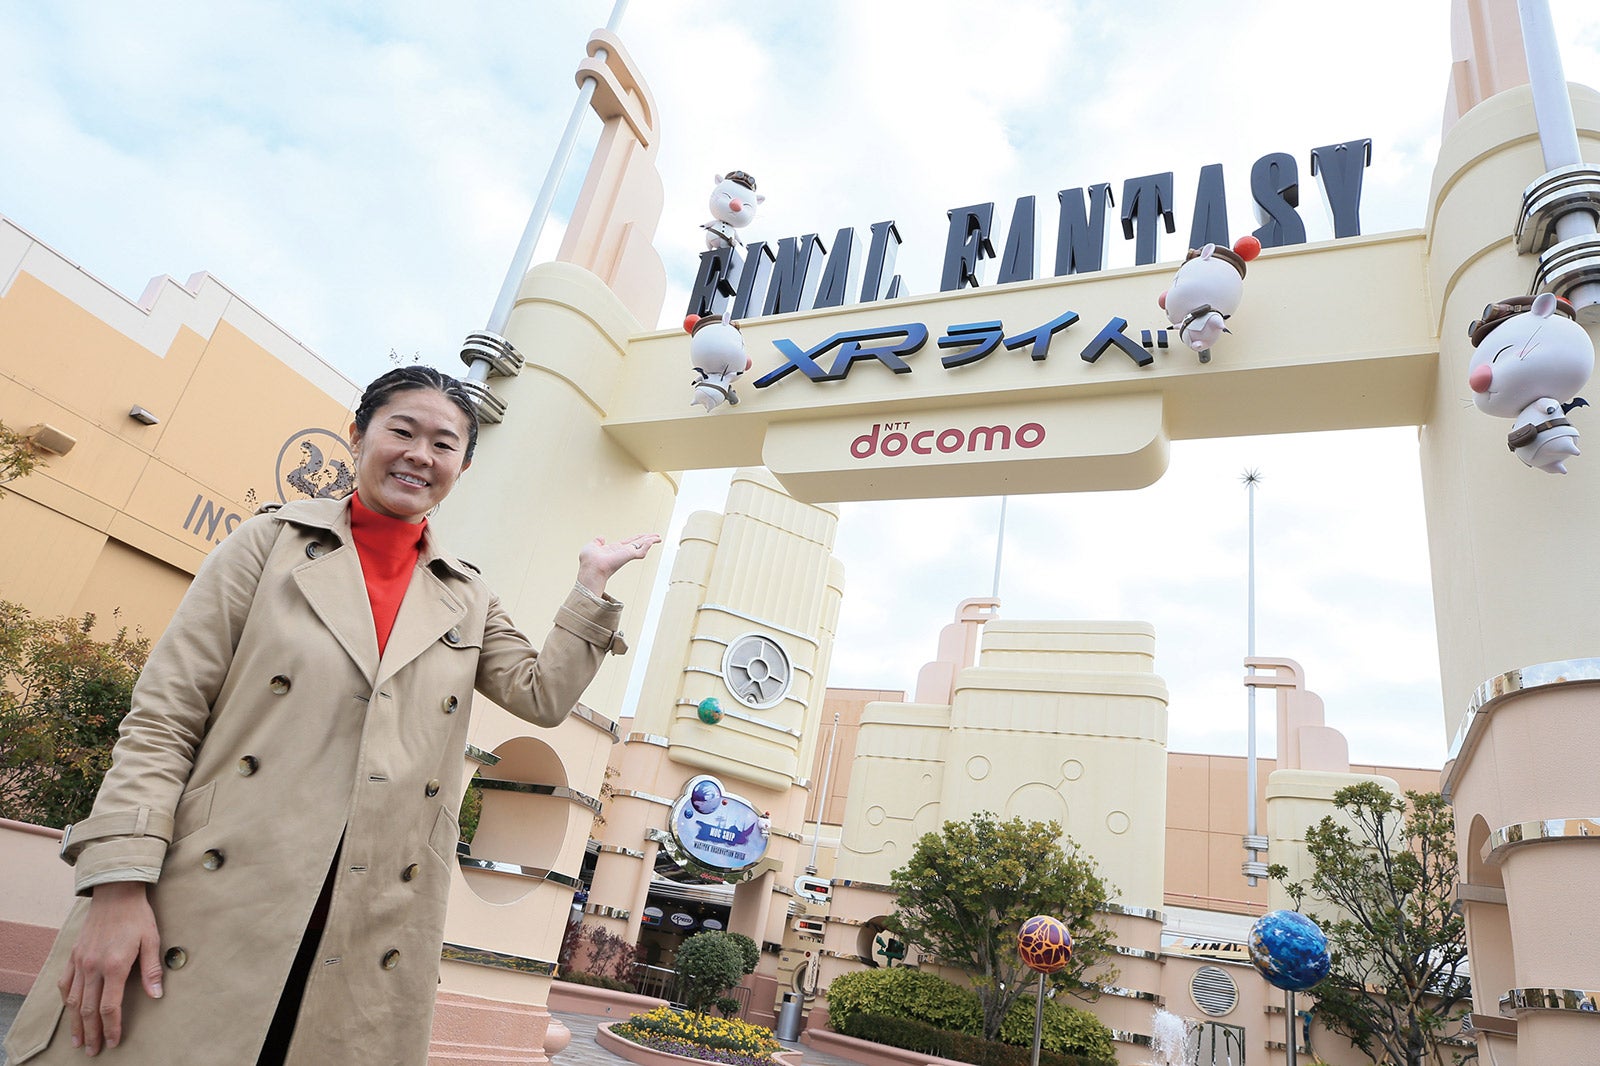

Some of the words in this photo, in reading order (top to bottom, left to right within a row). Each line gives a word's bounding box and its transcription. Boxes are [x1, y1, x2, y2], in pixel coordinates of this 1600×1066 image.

[686, 220, 907, 318] FINAL
[939, 138, 1372, 291] FANTASY
[884, 421, 911, 431] NTT
[850, 422, 1046, 459] docomo
[1190, 942, 1241, 952] FINAL
